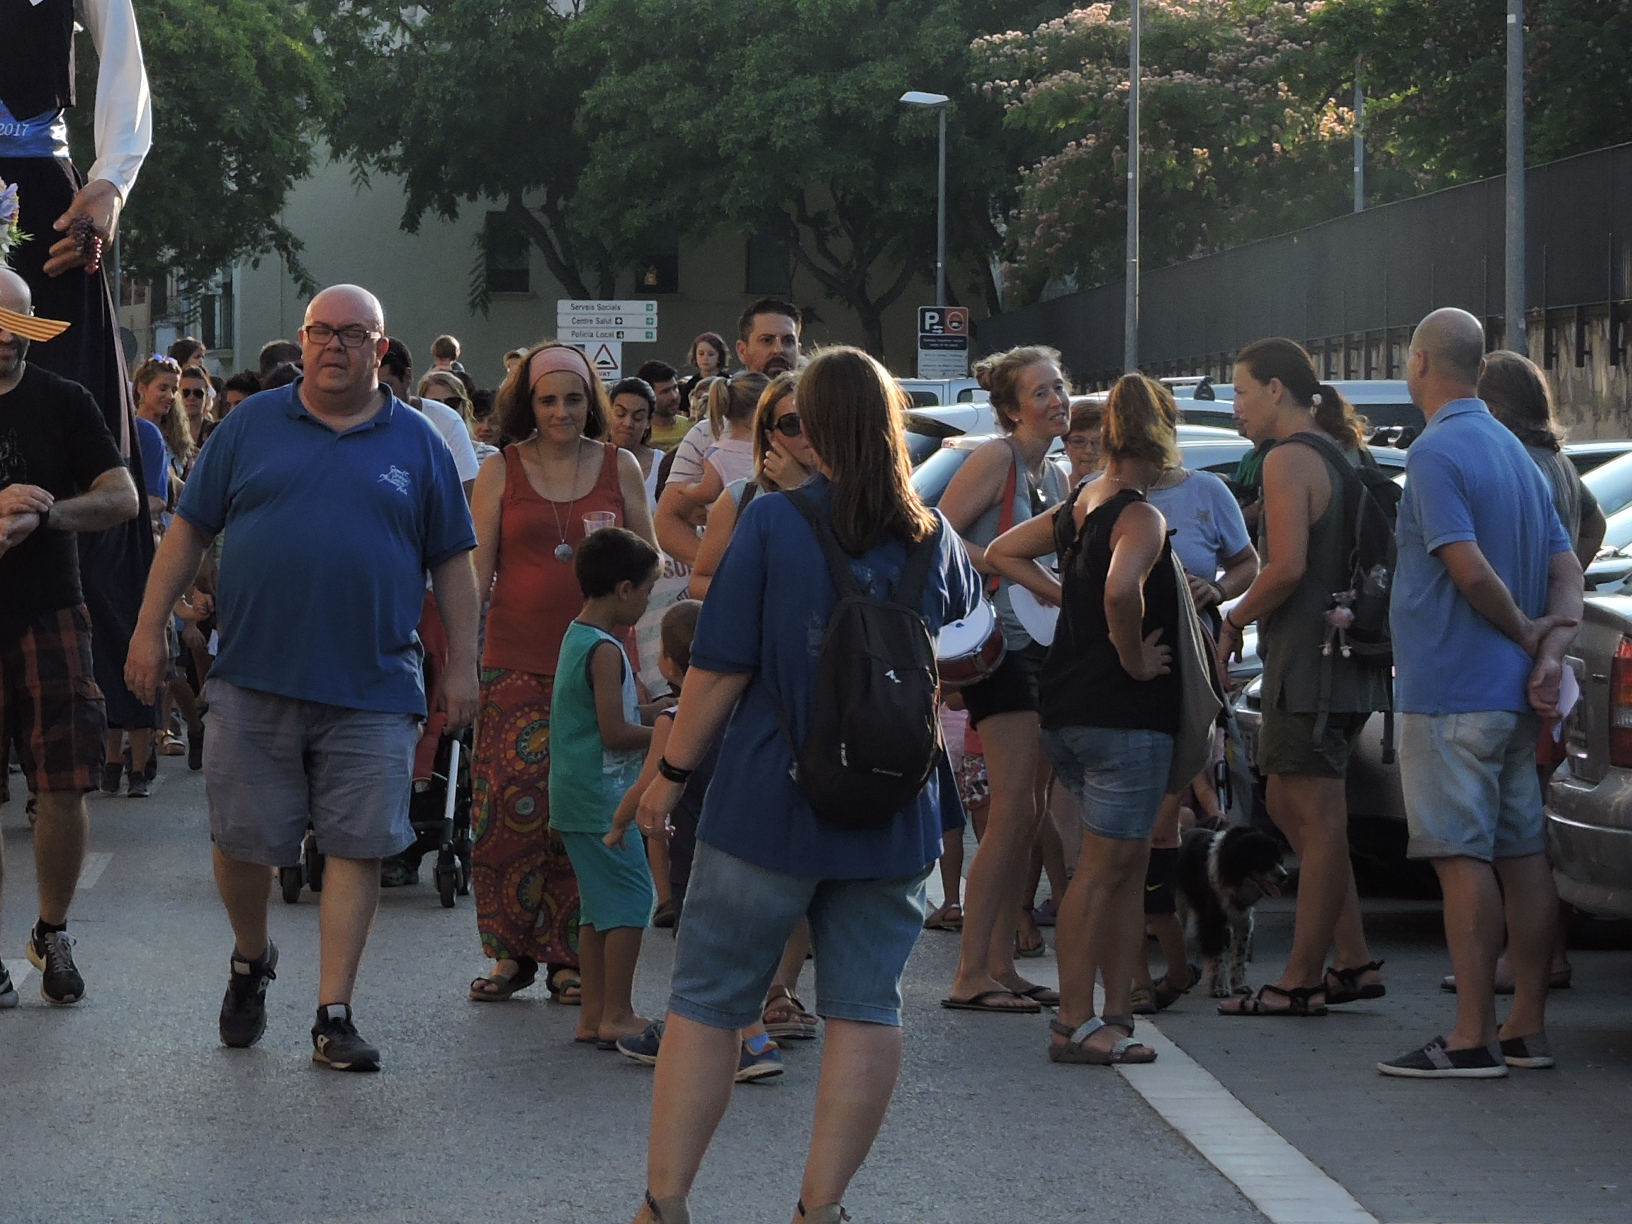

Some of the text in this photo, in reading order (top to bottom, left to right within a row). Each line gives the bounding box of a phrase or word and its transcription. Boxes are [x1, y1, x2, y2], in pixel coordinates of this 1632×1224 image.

[570, 303, 621, 311] Serveis Socials
[571, 317, 612, 325] Centre Salut
[924, 311, 940, 330] P
[595, 330, 615, 338] Local
